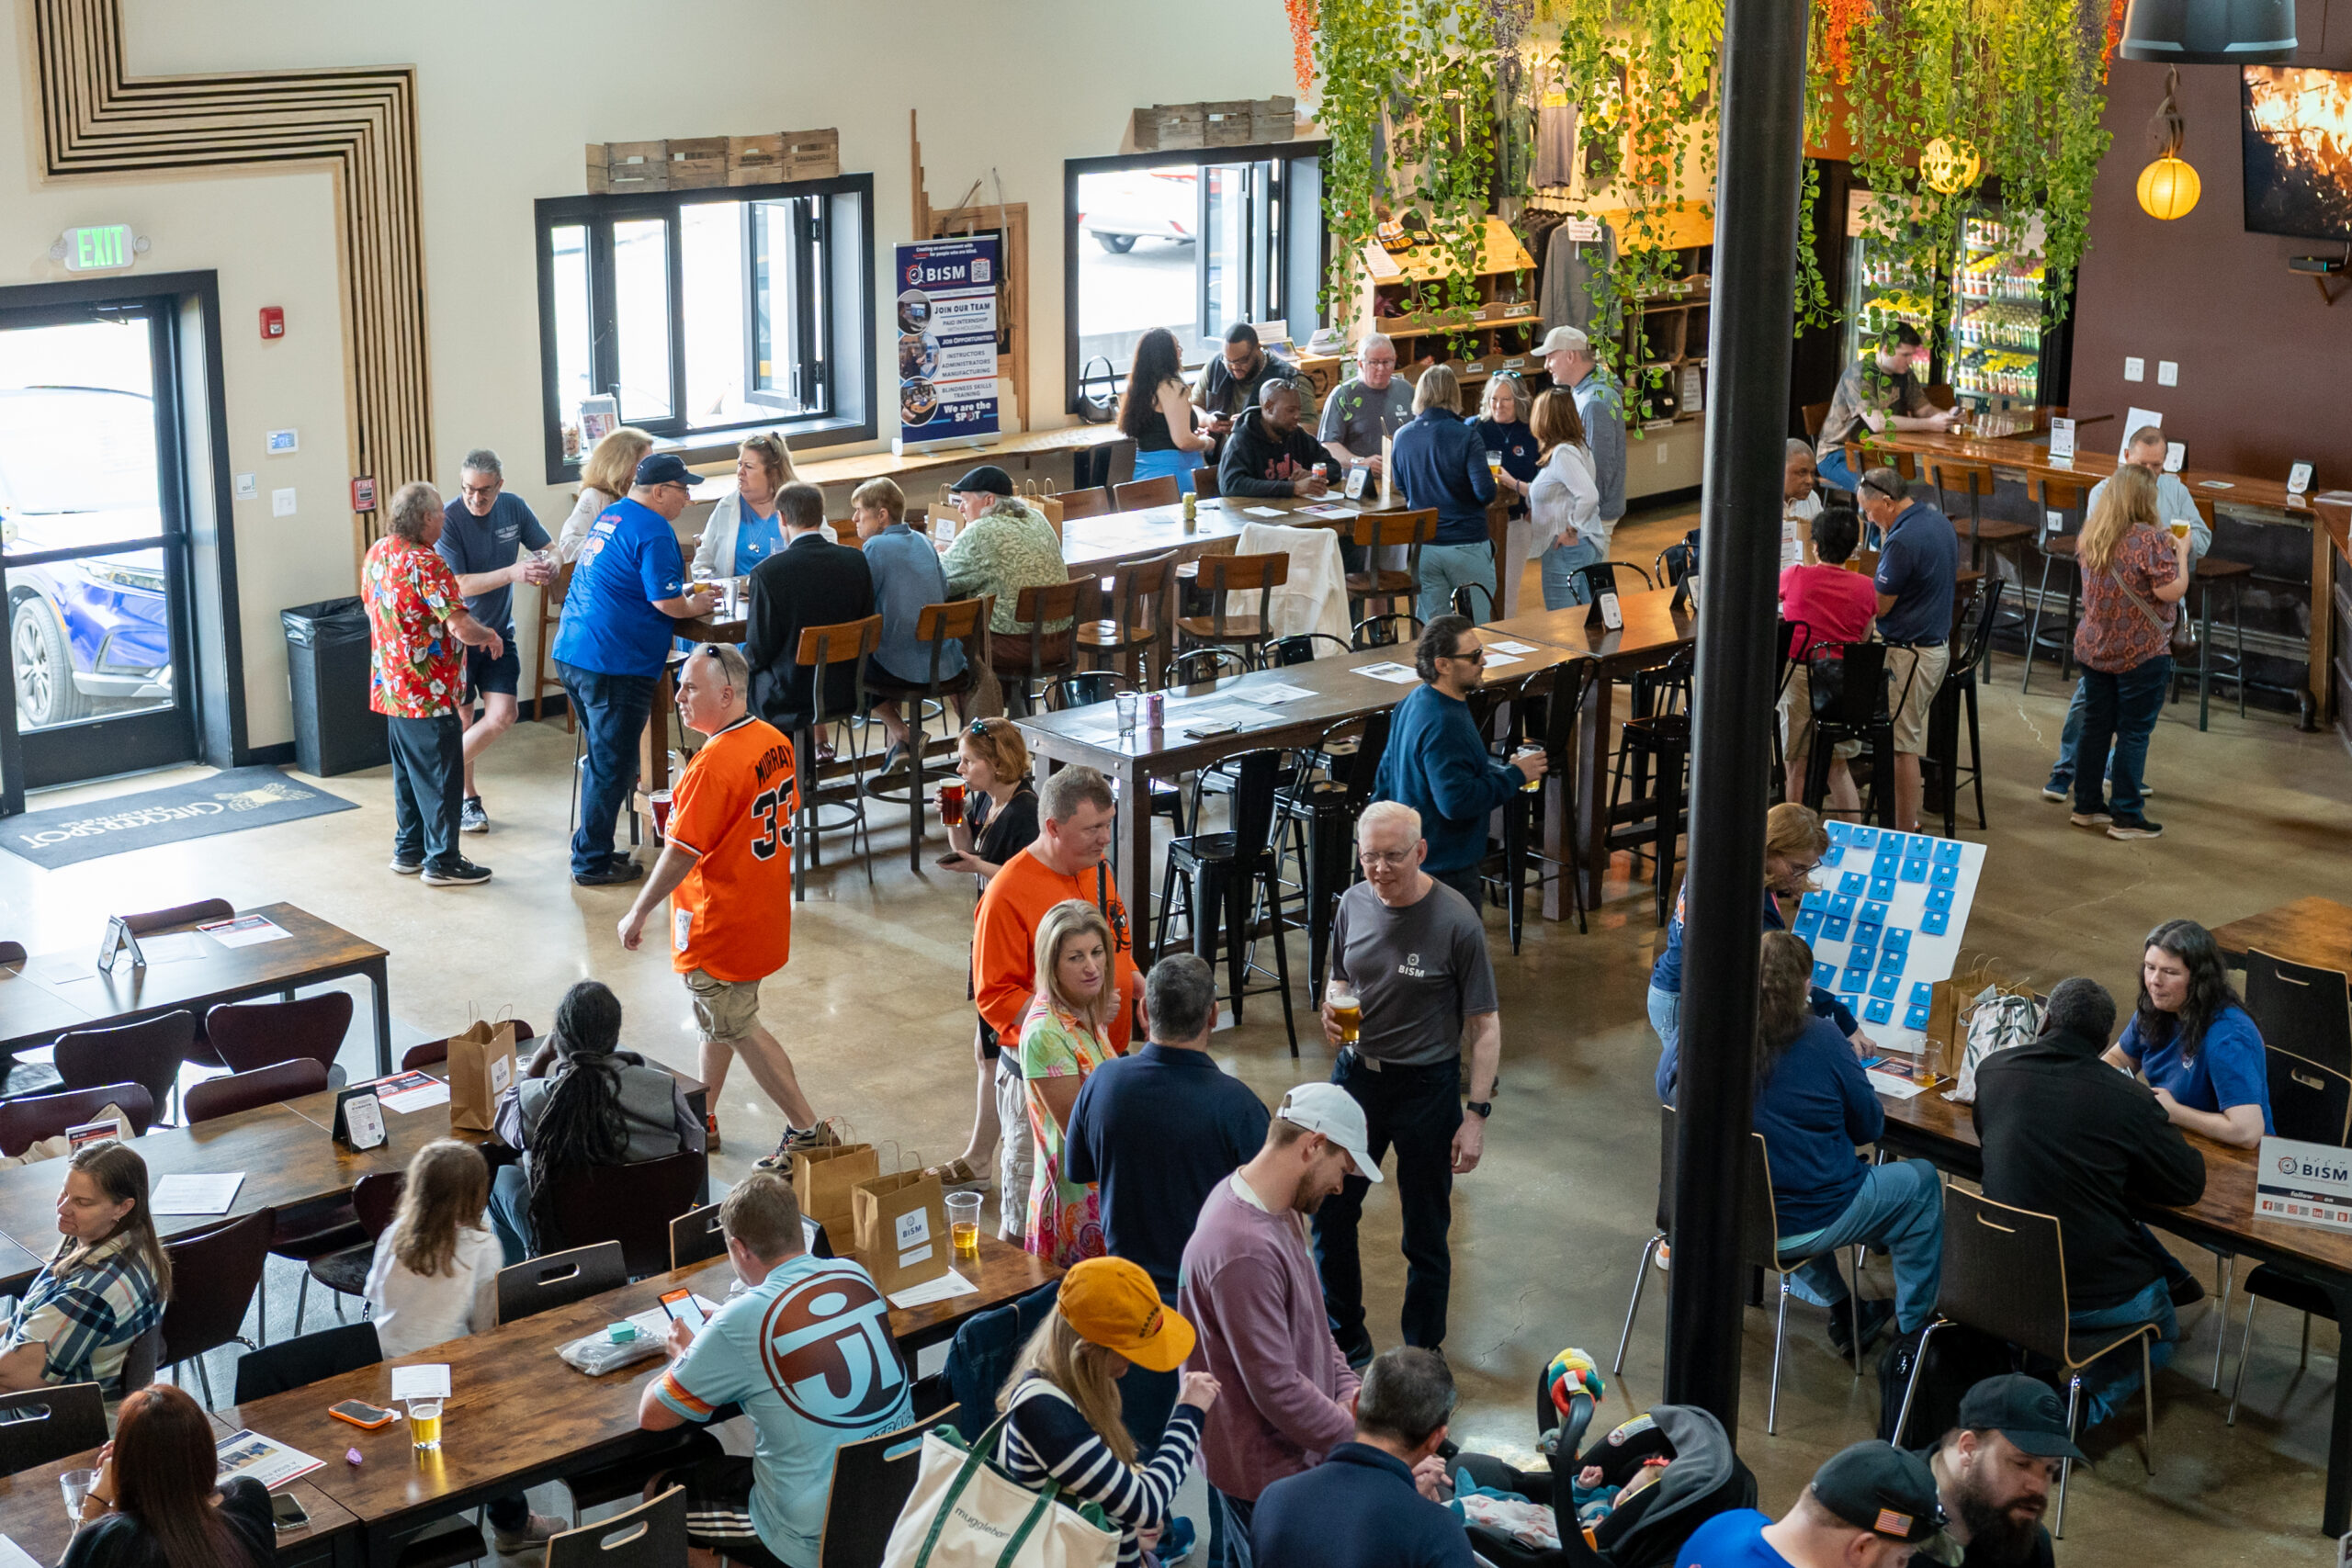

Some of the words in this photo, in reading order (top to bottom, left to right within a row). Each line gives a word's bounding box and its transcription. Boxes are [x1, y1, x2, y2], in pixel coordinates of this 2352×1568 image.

[77, 226, 124, 268] EXIT
[926, 265, 966, 282] BISM
[934, 306, 952, 315] JOIN
[954, 304, 968, 312] OUR
[970, 302, 990, 311] TEAM
[956, 317, 989, 325] INTERNSHIP
[946, 350, 985, 359] INSTRUCTORS
[942, 358, 991, 368] ADMINISTRATORS
[942, 367, 991, 378] MANUFACTURING
[944, 405, 958, 413] We
[960, 404, 974, 412] are
[976, 401, 991, 410] the
[755, 745, 793, 788] MURRAY
[752, 774, 794, 861] 33
[18, 801, 224, 849] CHECKERSPOT
[1887, 841, 1894, 850] 3
[1944, 849, 1952, 858] 5
[1914, 868, 1920, 878] 9
[1846, 880, 1860, 890] 12
[1937, 875, 1950, 884] 10
[1882, 958, 1899, 970] 29
[1397, 964, 1425, 977] BISM
[1910, 1016, 1928, 1027] 40
[2302, 1164, 2348, 1181] BISM
[2290, 1190, 2314, 1200] follow
[902, 1224, 922, 1238] BISM
